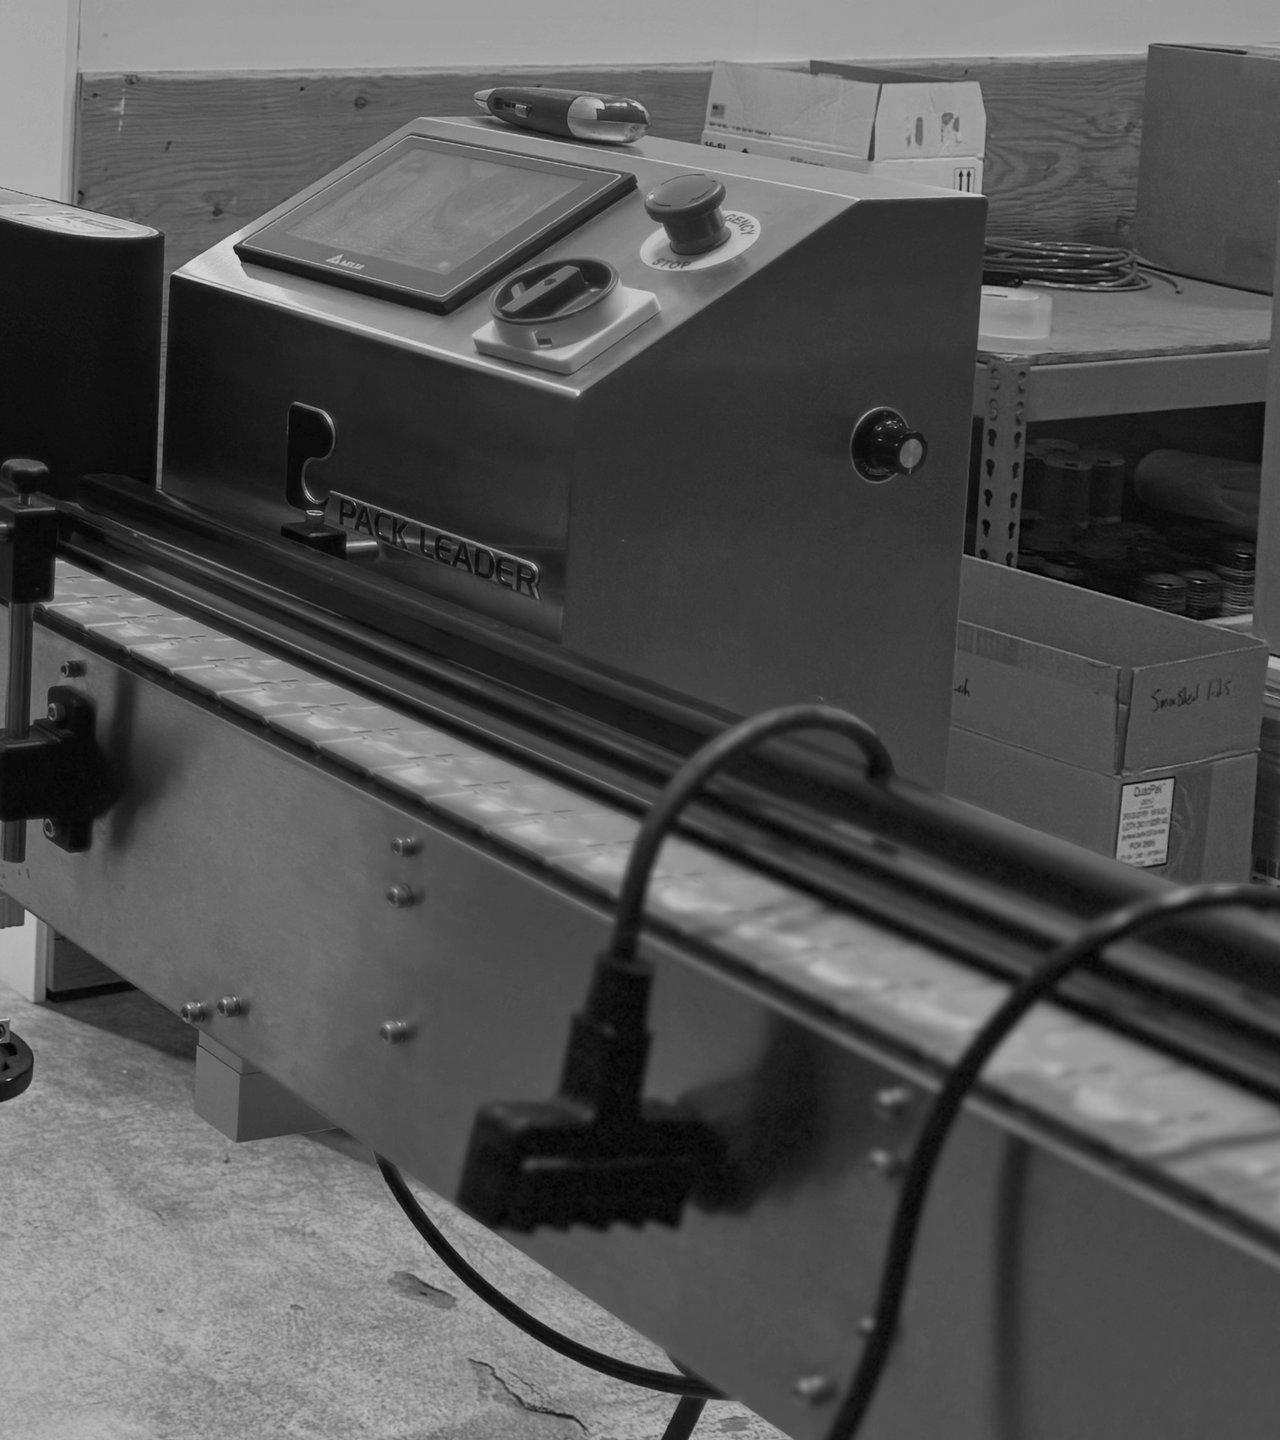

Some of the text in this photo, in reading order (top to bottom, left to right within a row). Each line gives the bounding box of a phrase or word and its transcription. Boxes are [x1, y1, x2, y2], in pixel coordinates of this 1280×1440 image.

[724, 213, 755, 236] GENCY
[652, 257, 691, 270] STOP
[338, 497, 542, 600] PACK LEADER
